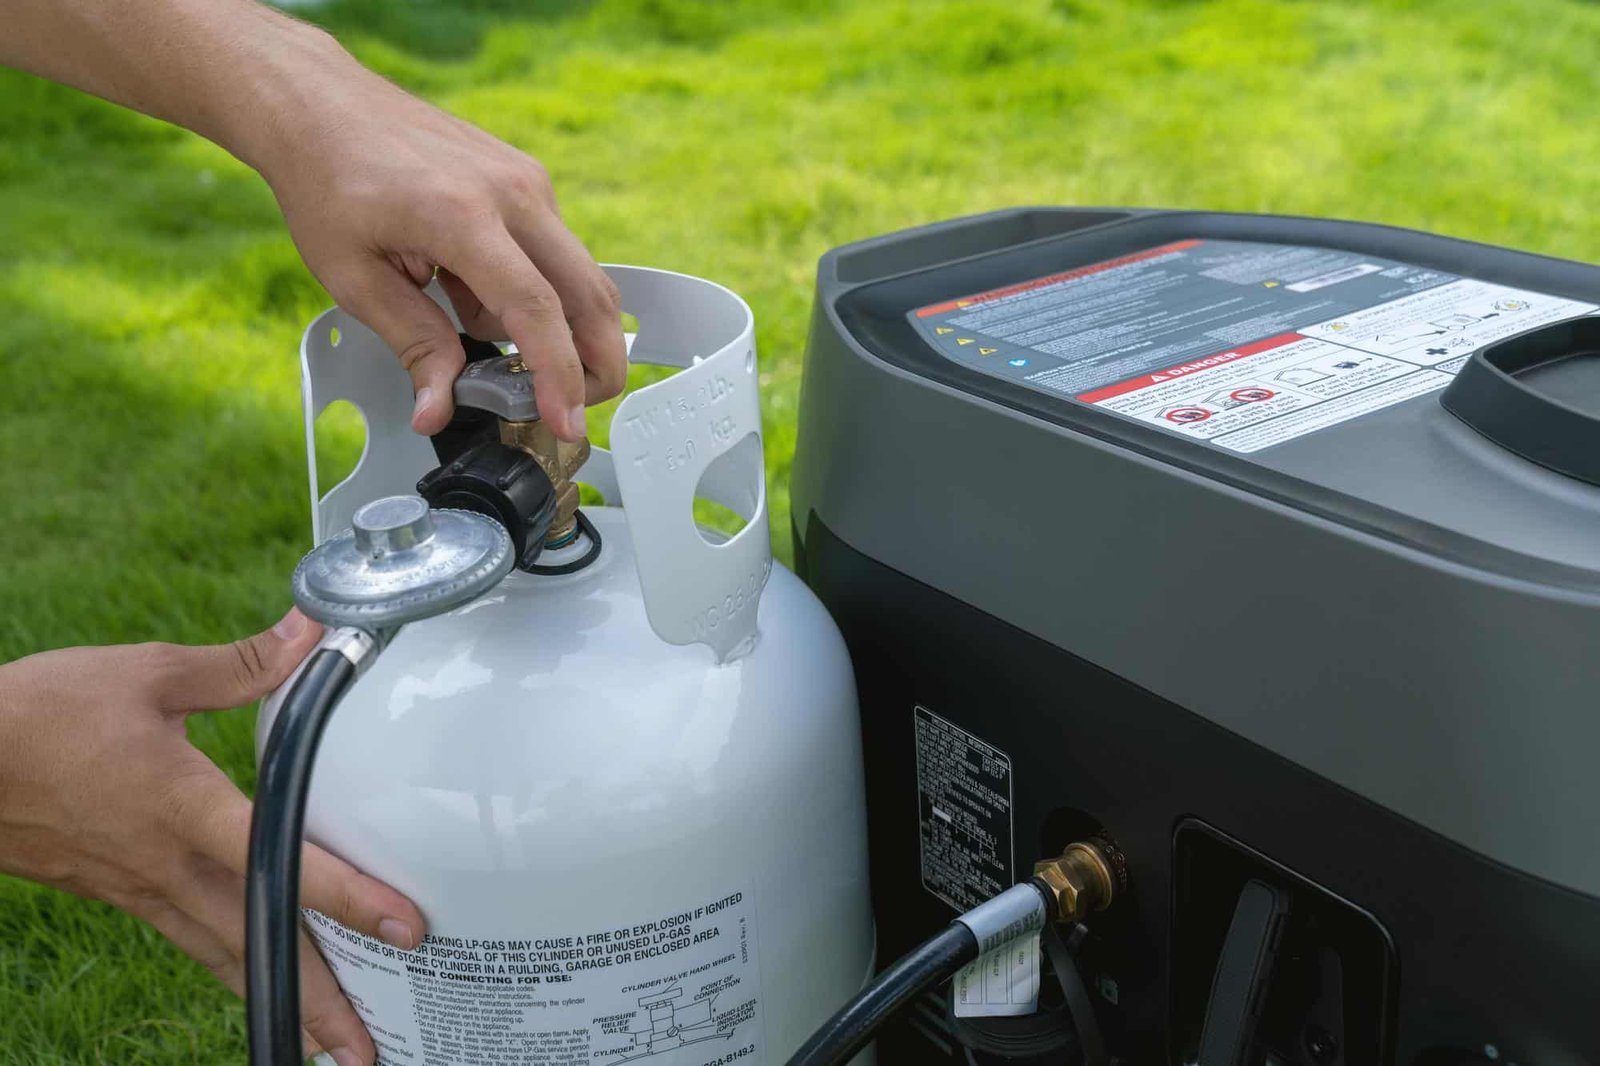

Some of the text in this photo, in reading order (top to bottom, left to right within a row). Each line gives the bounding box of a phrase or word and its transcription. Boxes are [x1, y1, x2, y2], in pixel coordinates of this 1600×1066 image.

[1168, 352, 1242, 376] DANGER
[422, 892, 743, 951] EAKING LP-GAS MAY CAUSE A FIRE OR EXPLOSION IF IGNITED
[333, 925, 345, 939] DO
[346, 932, 361, 947] NOT
[364, 941, 381, 954] USE
[382, 946, 395, 959] OR
[397, 951, 429, 967] STORE
[431, 958, 481, 973] CYLINDER
[484, 964, 494, 974] IN
[498, 965, 506, 974] A
[566, 956, 613, 972] GARAGE
[615, 952, 631, 965] OR
[634, 937, 691, 961] ENCLOSED
[693, 927, 720, 945] AREA
[430, 946, 482, 962] DISPOSAL
[484, 952, 499, 962] OF
[501, 953, 526, 963] THIS
[529, 949, 584, 962] CYLINDER
[587, 946, 603, 957] OR
[606, 937, 650, 954] UNUSED
[653, 925, 691, 944] LP-GAS
[406, 965, 572, 984] WHEN CONNECTING FOR USE:
[622, 953, 736, 993] CYLINDER VALVE HAND WHEEL
[693, 977, 741, 1001] CONNECTION
[700, 974, 734, 992] POINT OF
[562, 998, 585, 1007] cylinder
[737, 998, 757, 1013] LEVEL
[592, 1011, 637, 1025] PRESSURE
[601, 1019, 630, 1029] RELIEF
[716, 1006, 754, 1025] INDICATOR
[603, 1025, 630, 1035] VALVE
[593, 1045, 634, 1057] CYLINDER
